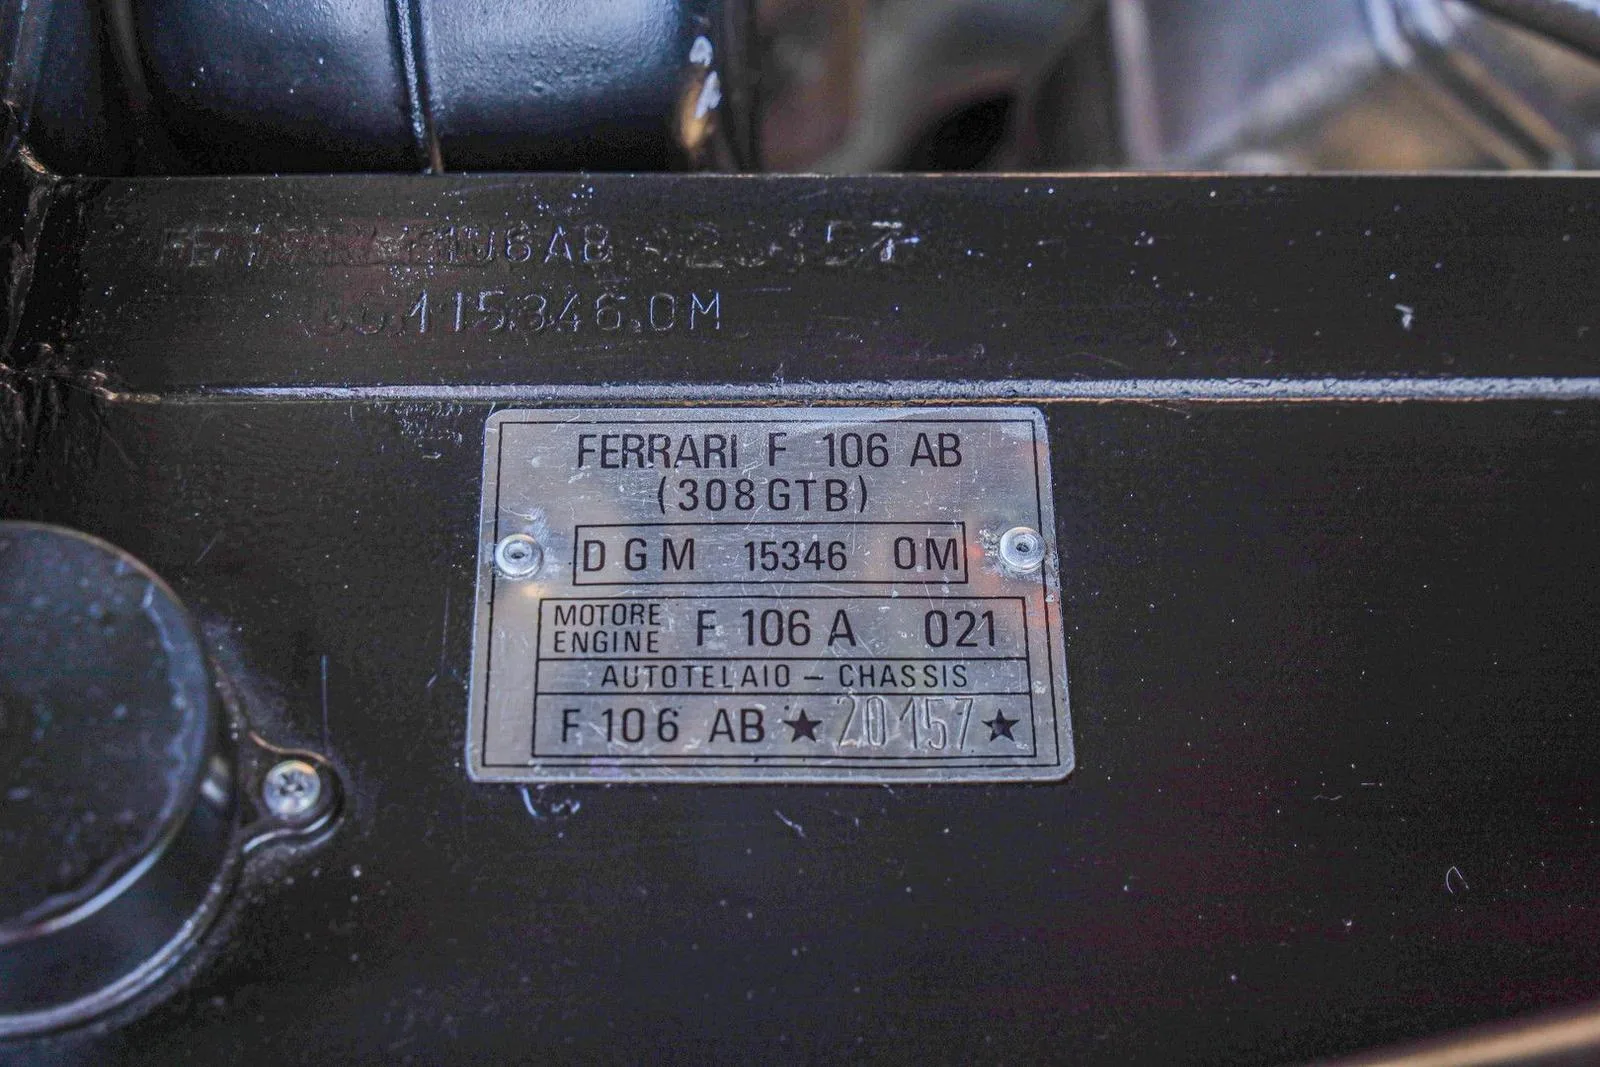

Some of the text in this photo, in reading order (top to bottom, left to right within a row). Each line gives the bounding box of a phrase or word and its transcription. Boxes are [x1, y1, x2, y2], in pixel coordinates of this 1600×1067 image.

[578, 432, 962, 469] FERRARI F 106 AB
[744, 540, 848, 572] 15346
[554, 603, 661, 627] MOTORE
[696, 609, 996, 647] F 106 A 021
[554, 630, 660, 653] ENGINE
[601, 664, 790, 688] AUTOTELAIO
[838, 663, 968, 688] CHASSIS
[562, 708, 581, 743] F
[601, 708, 680, 743] 106
[708, 708, 766, 743] AB
